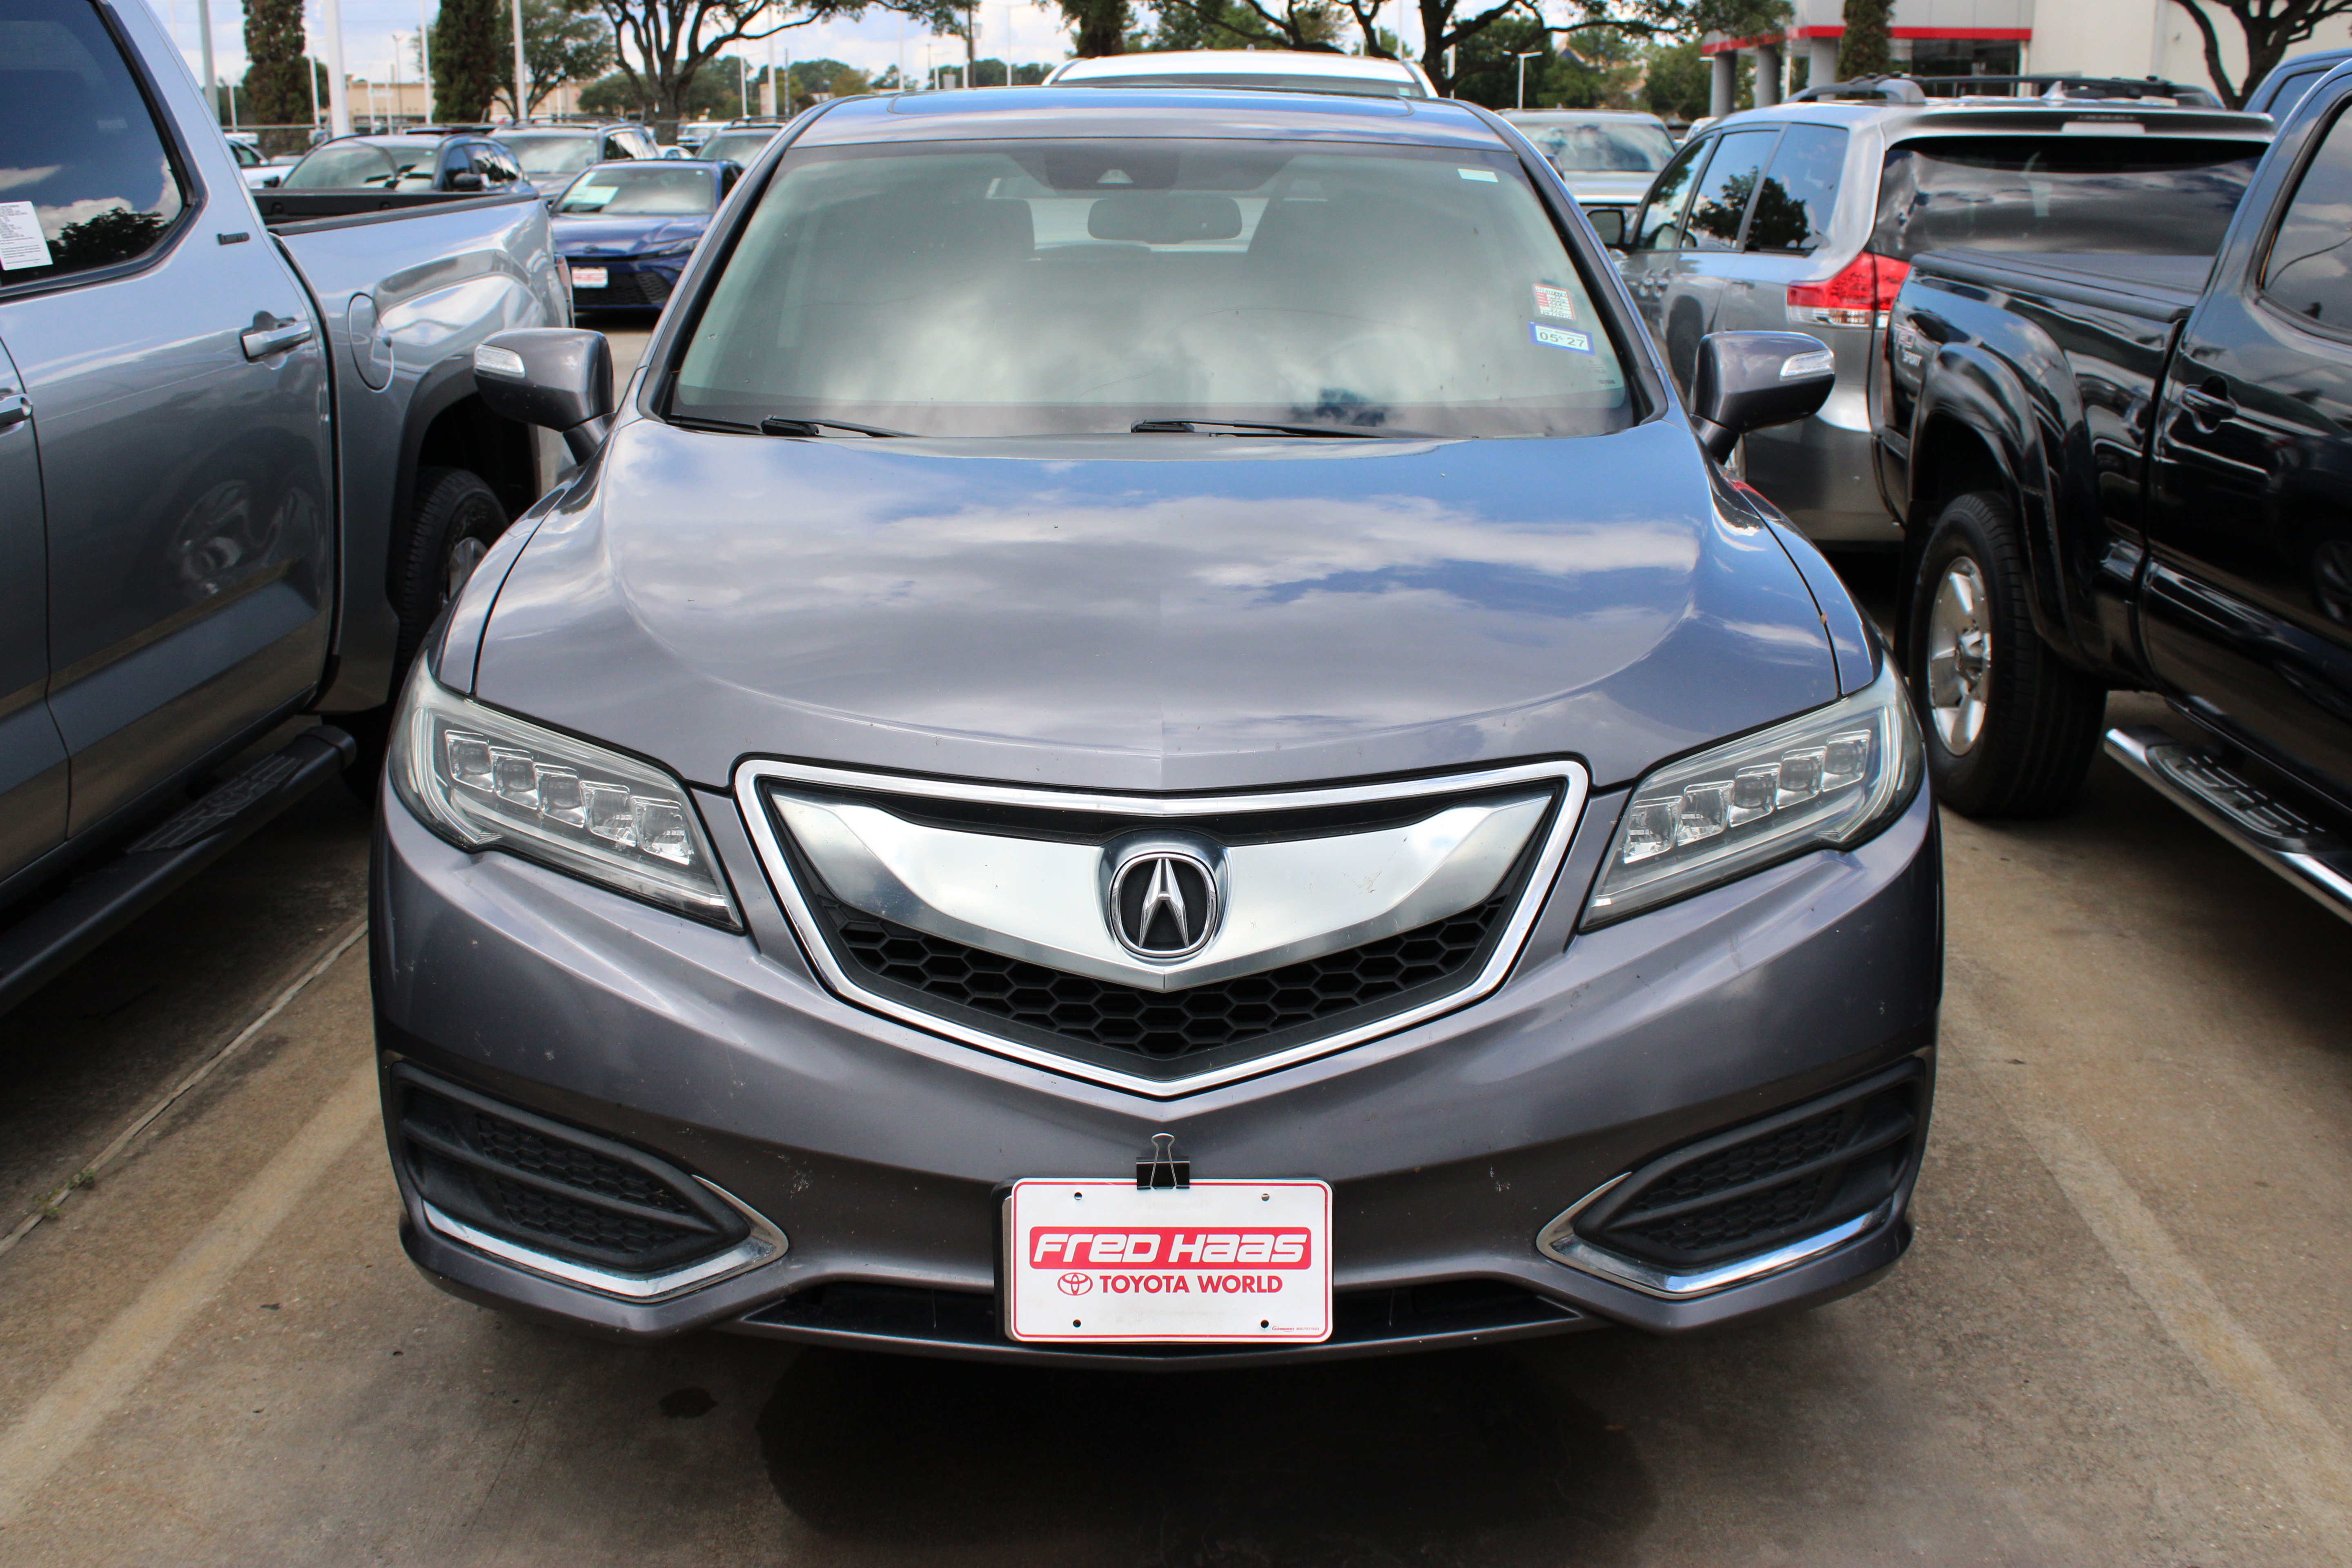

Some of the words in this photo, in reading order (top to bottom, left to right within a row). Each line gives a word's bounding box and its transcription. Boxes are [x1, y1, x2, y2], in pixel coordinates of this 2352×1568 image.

[1539, 332, 1559, 343] 05
[1567, 337, 1585, 347] 27
[1099, 1275, 1190, 1293] TOYOTA
[1197, 1275, 1283, 1294] WORLD
